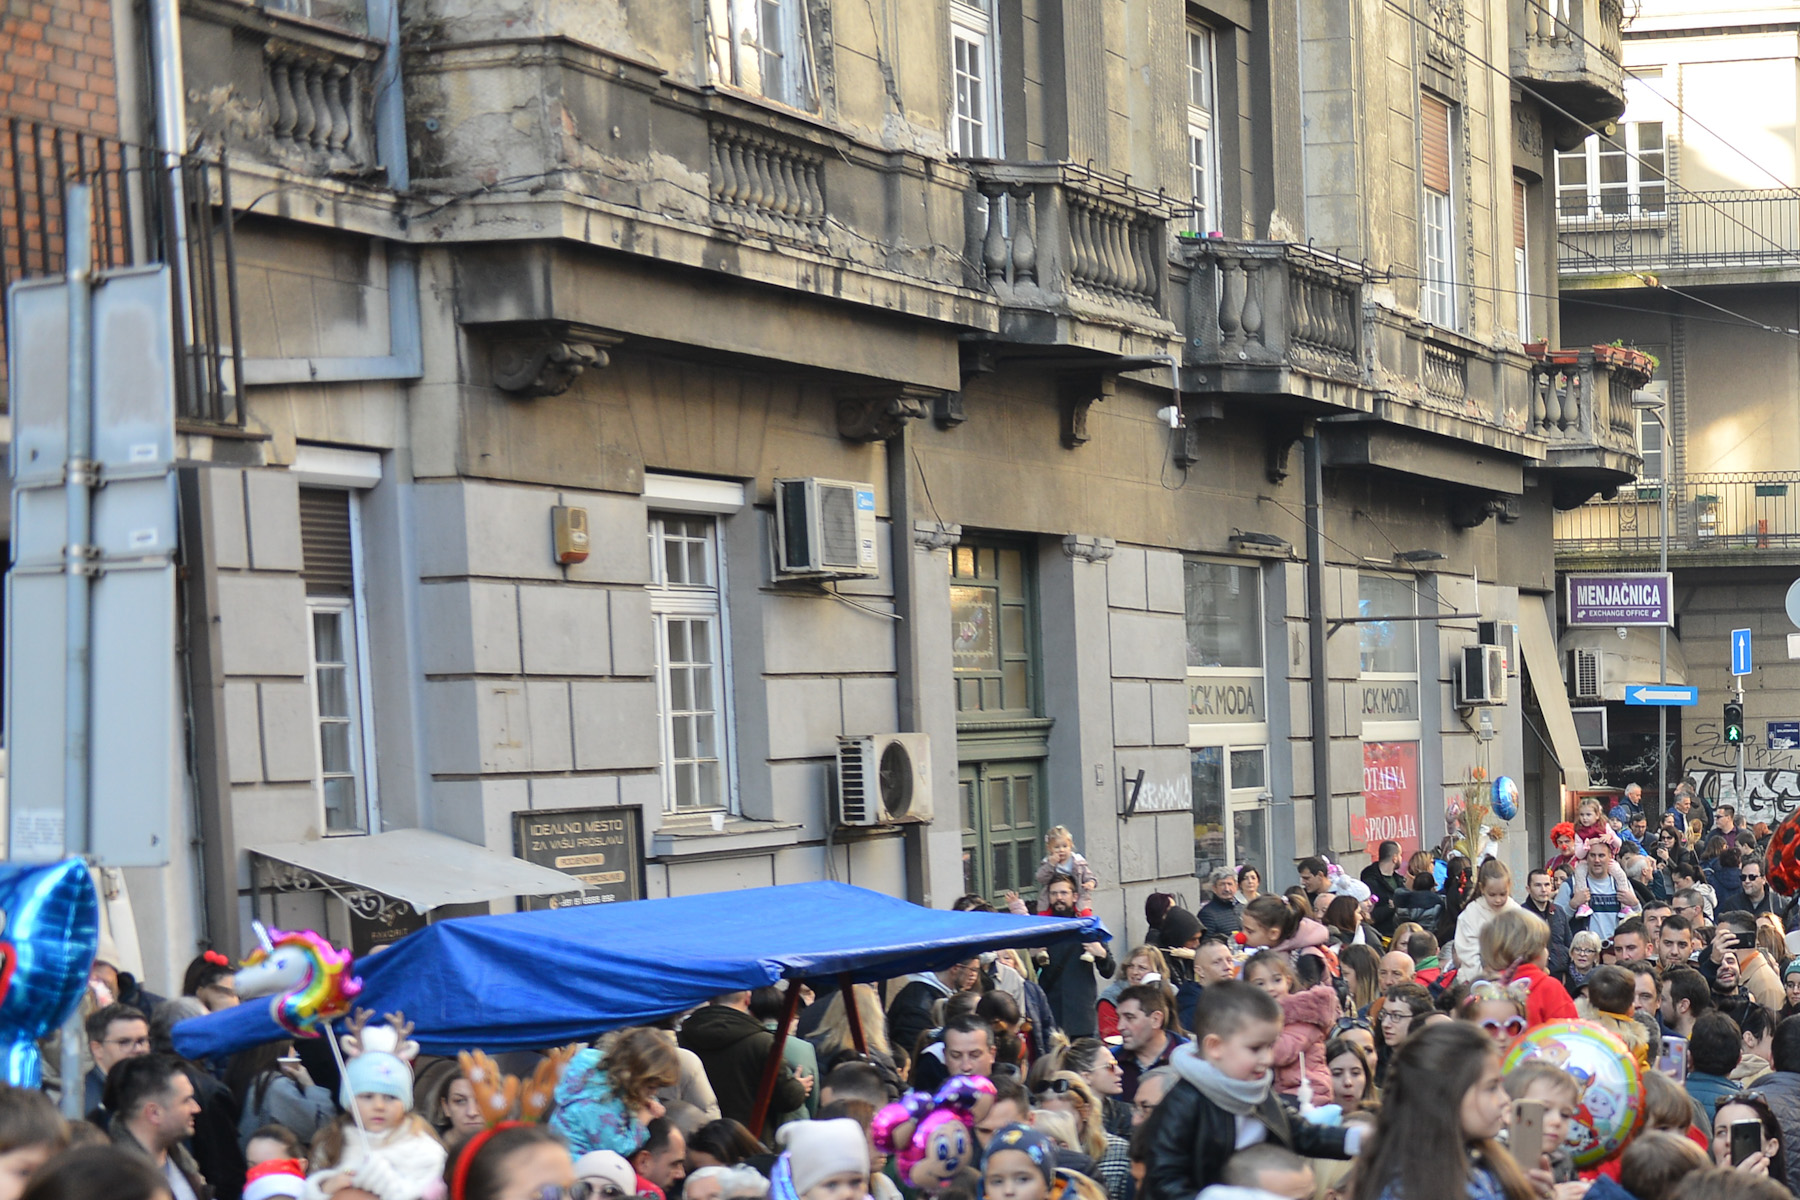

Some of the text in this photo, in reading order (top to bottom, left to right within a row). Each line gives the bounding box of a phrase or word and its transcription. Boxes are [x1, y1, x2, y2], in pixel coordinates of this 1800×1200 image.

[1577, 582, 1661, 606] MENJAČNICA
[1589, 609, 1649, 617] EXCHANGE OFFICE
[1216, 685, 1256, 715] MODA
[1381, 687, 1412, 714] MODA
[1364, 766, 1407, 791] OTALNA
[530, 819, 624, 836] IDEALNO MESTO
[1364, 814, 1417, 842] SPRODAJA
[532, 835, 625, 851] ZA VAŠU PROSLAVU
